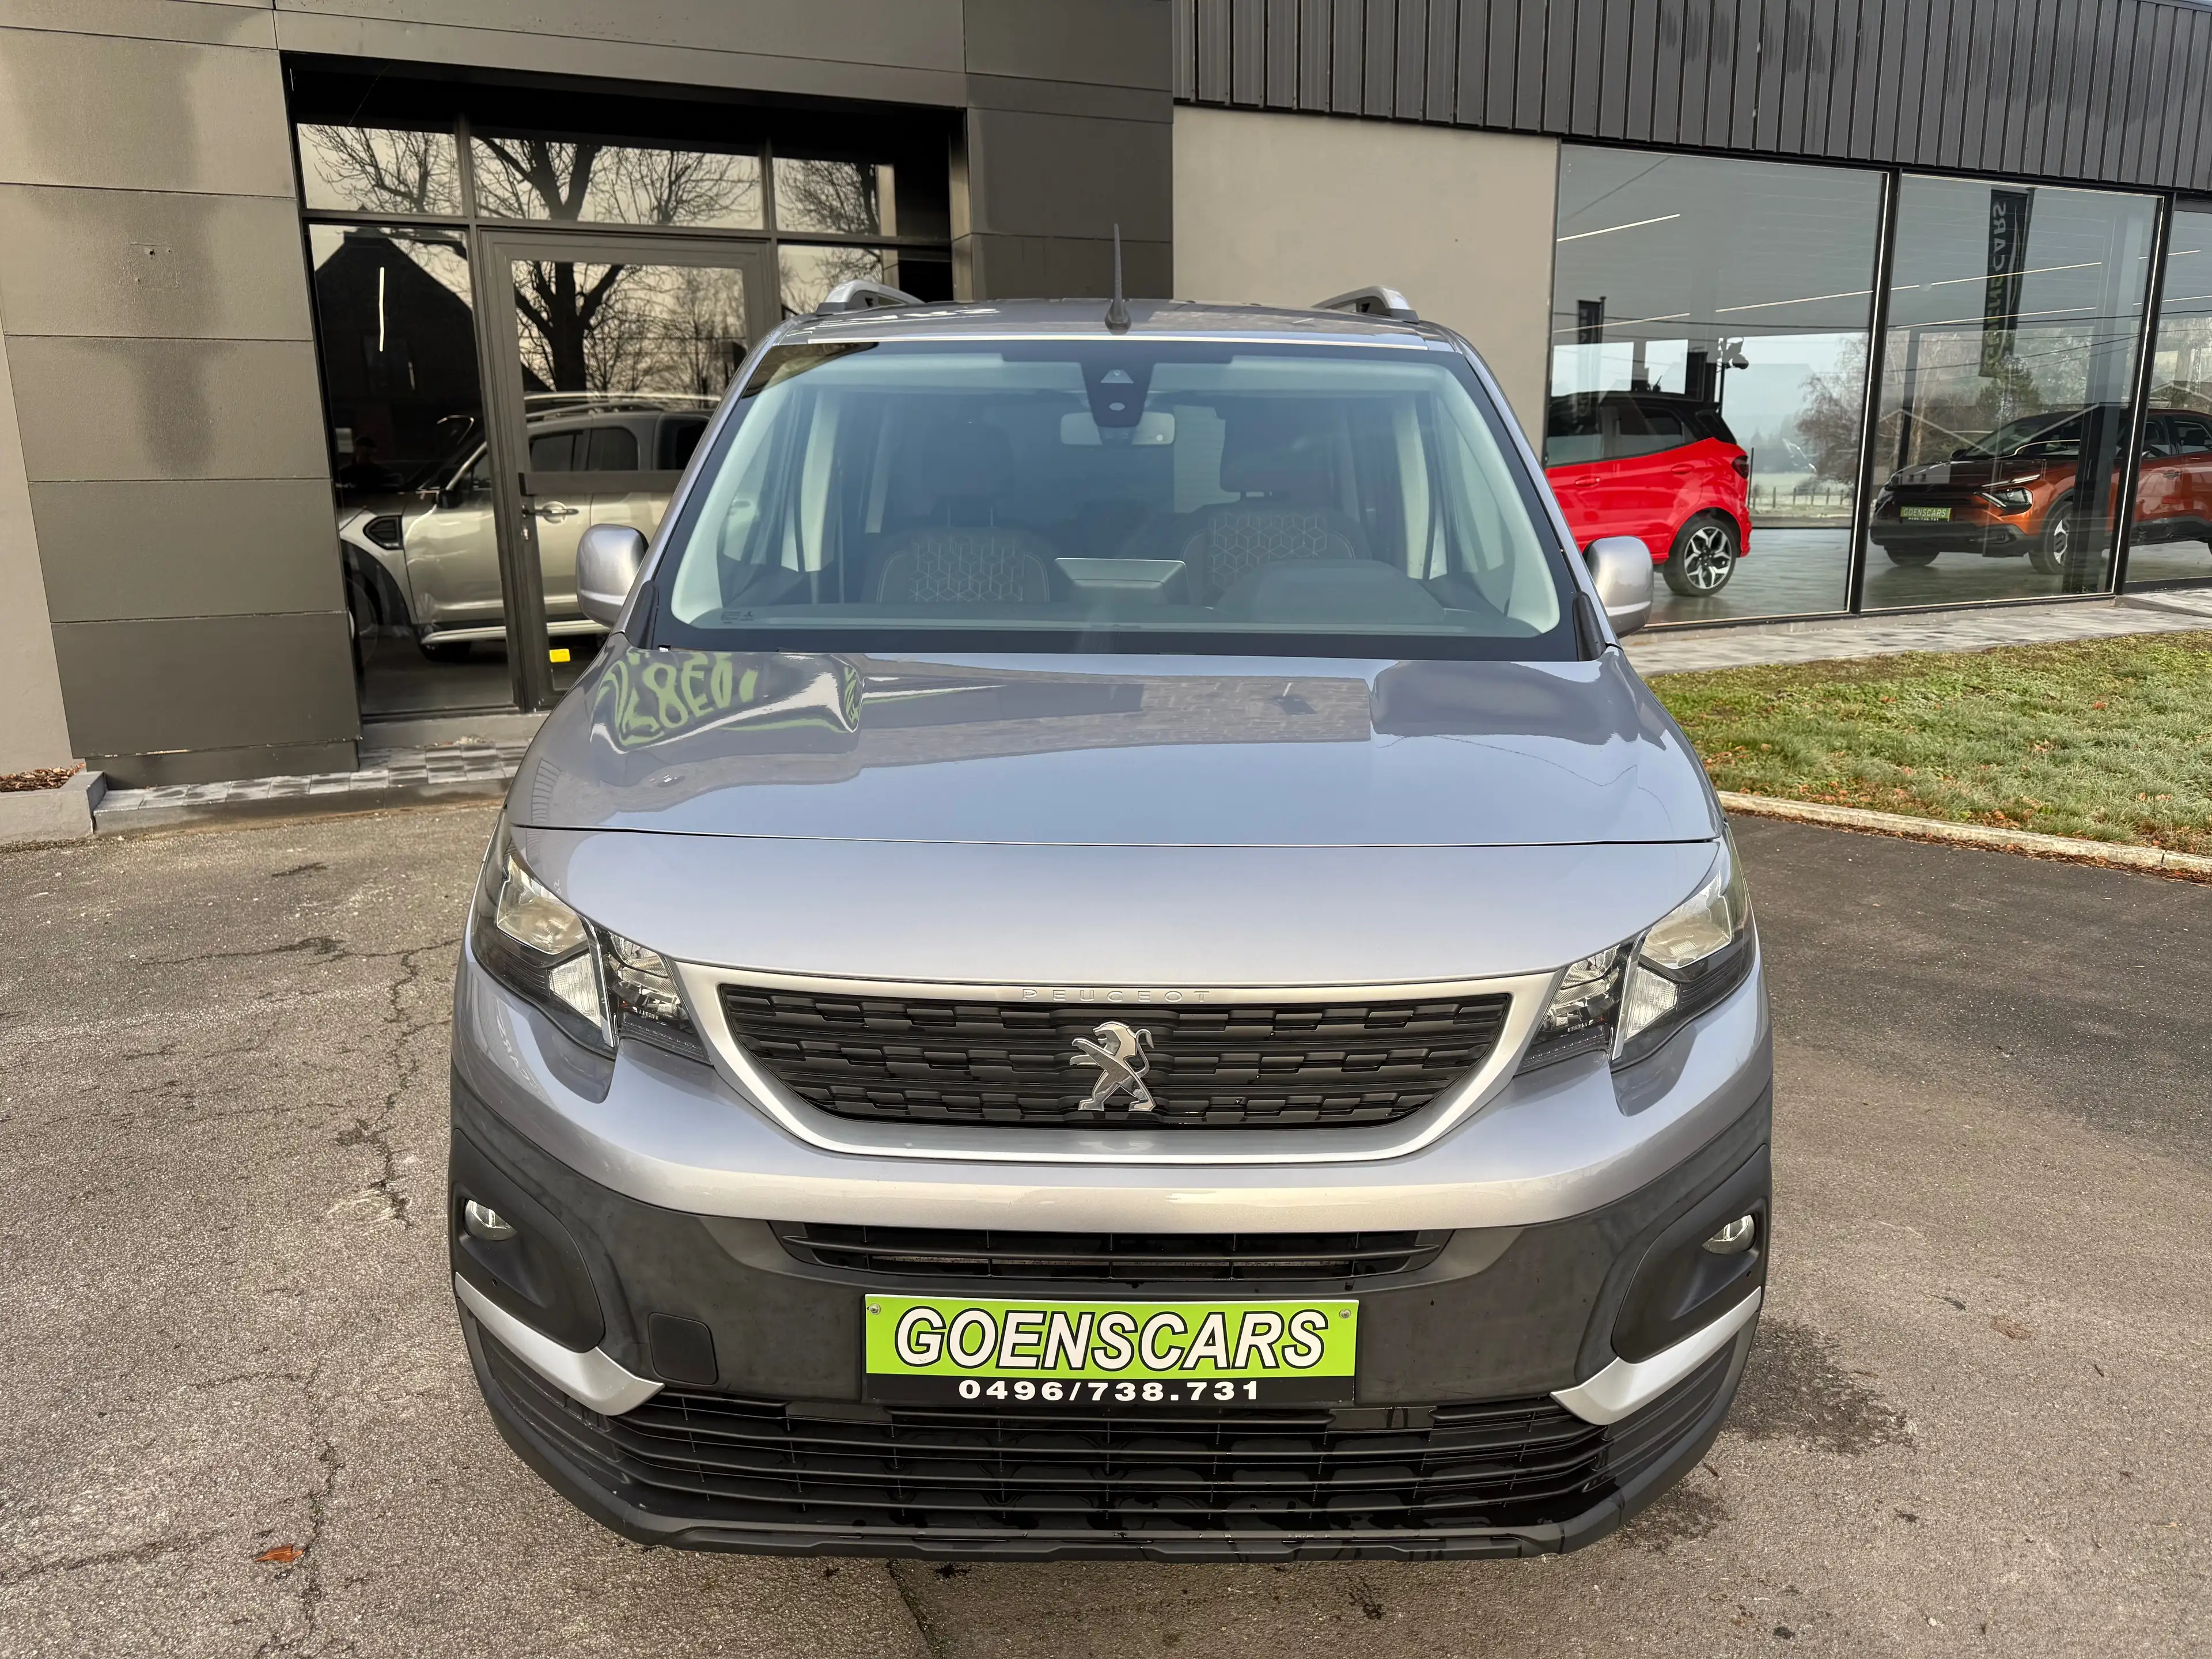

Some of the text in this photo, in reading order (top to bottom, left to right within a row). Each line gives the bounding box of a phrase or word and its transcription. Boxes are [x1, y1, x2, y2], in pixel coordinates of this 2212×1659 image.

[1904, 507, 1946, 517] GOENSCARS
[1022, 989, 1209, 1002] PEUGEOT
[894, 1305, 1329, 1372] GOENSCARS
[959, 1380, 1258, 1402] 0496/738.731
